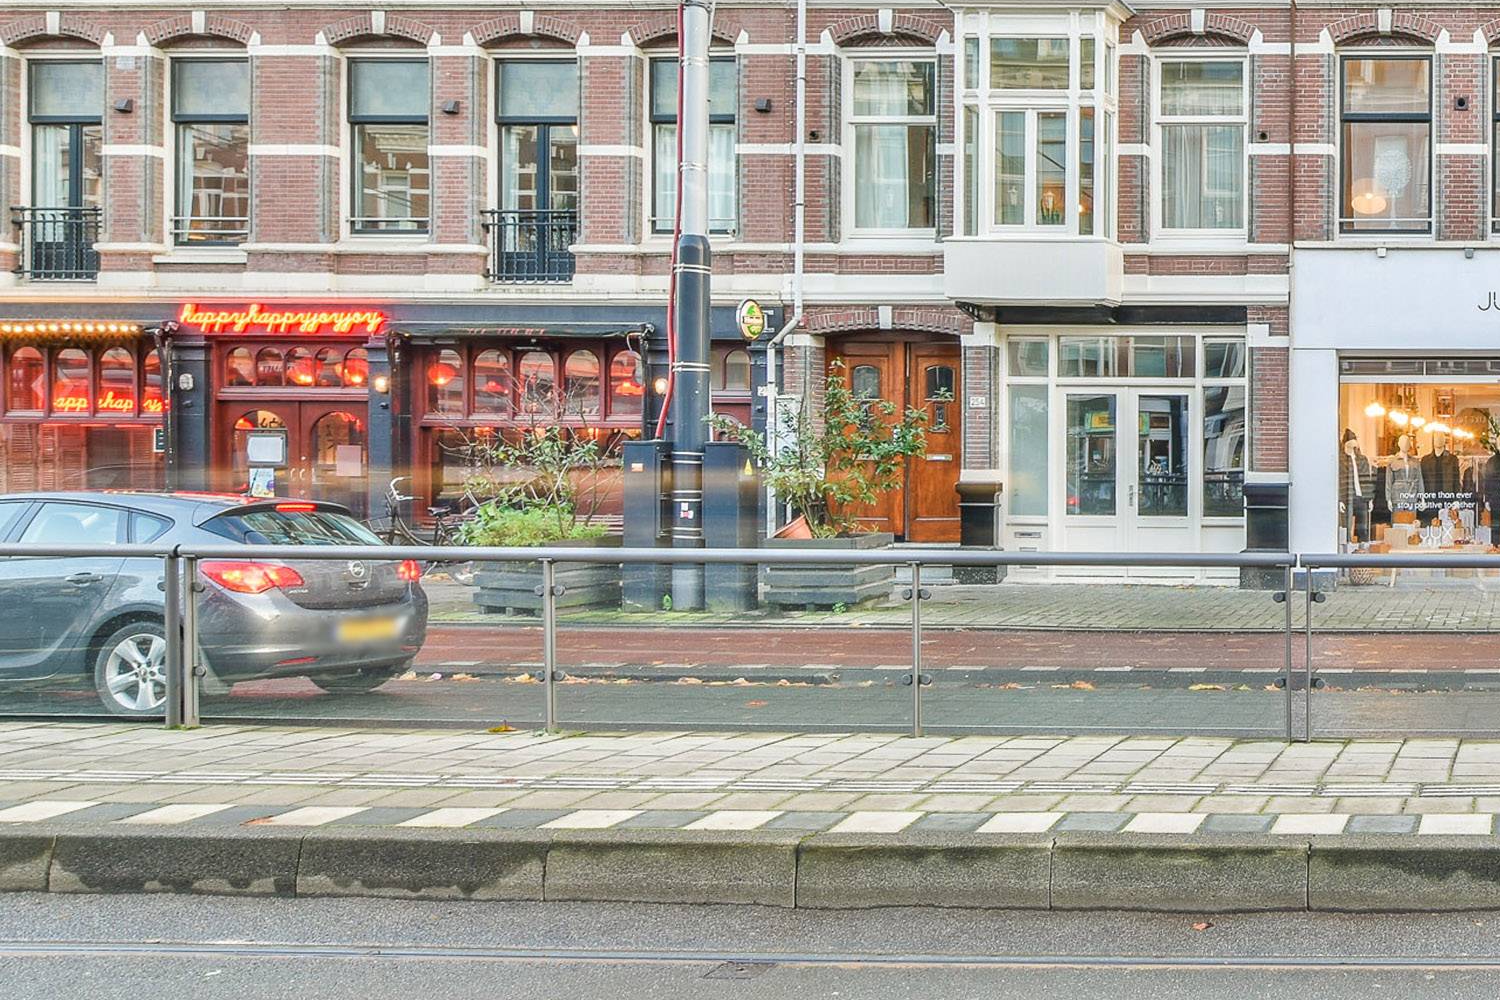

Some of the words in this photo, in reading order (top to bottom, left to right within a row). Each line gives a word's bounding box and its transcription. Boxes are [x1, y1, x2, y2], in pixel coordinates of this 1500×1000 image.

[180, 303, 384, 332] happyhappyjoyjoy
[1438, 491, 1454, 499] than
[1414, 502, 1442, 510] poitive
[1444, 502, 1475, 510] togther
